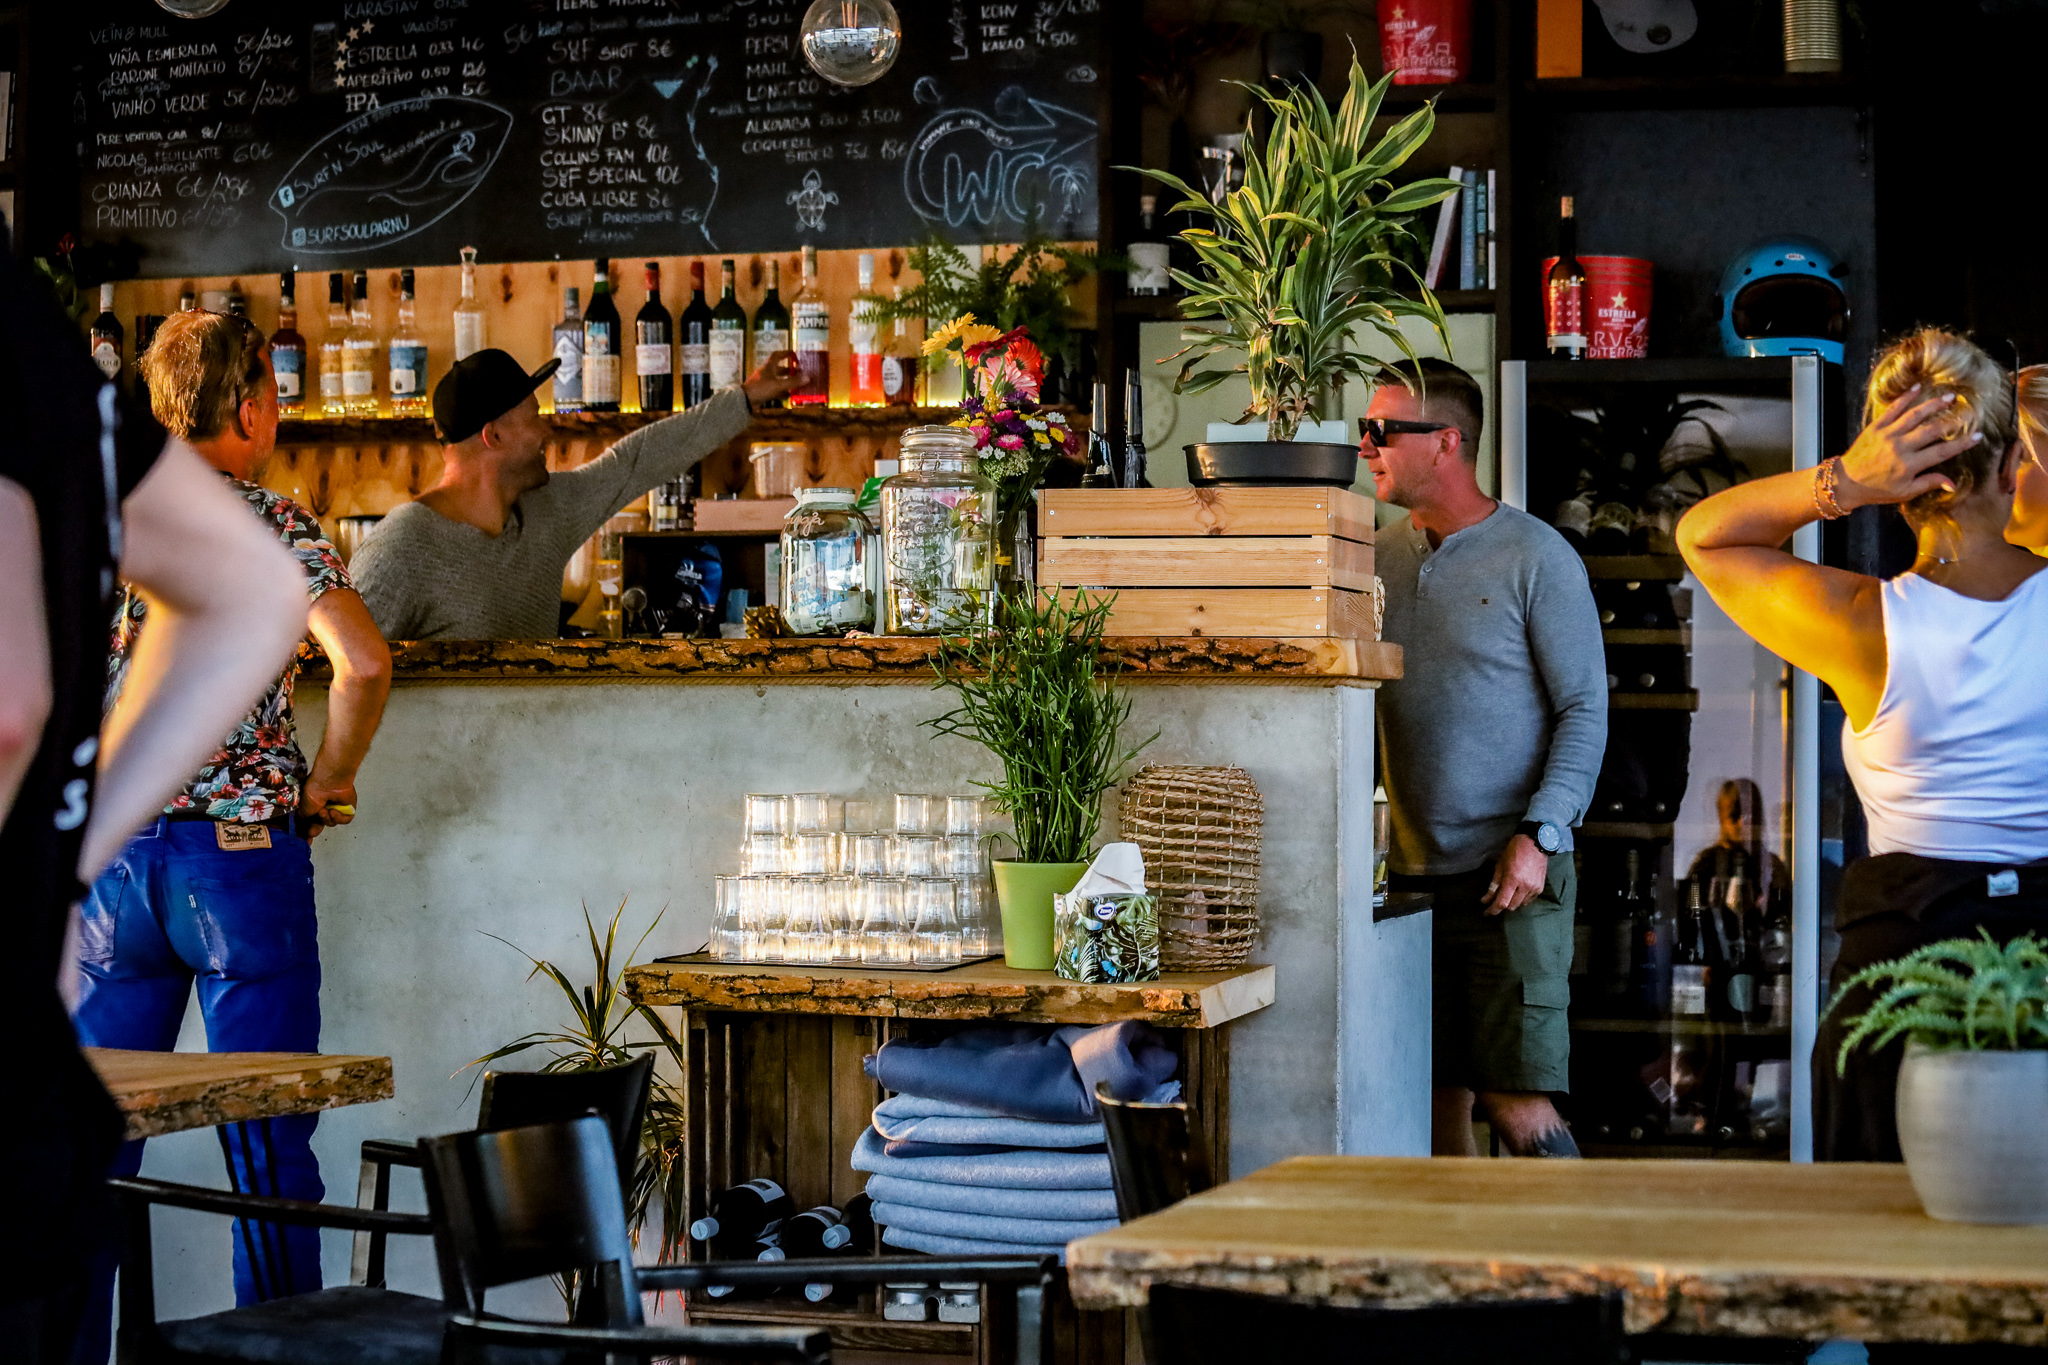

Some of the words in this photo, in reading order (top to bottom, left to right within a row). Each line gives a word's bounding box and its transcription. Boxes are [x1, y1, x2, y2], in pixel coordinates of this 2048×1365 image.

[139, 25, 170, 39] MULL
[979, 24, 1010, 37] TEE
[109, 47, 141, 66] VIÑA
[146, 42, 218, 63] ESMERALDA
[347, 43, 418, 67] ESTRELLA
[598, 42, 639, 61] SHOT
[646, 38, 674, 58] 8€
[110, 67, 160, 87] BARONE
[169, 61, 226, 80] MONTALTO
[346, 66, 414, 88] APERITIVO
[551, 66, 622, 96] BAAR
[112, 99, 156, 119] VINHO
[165, 92, 211, 115] VERDE
[345, 92, 381, 113] IPA
[541, 105, 572, 125] GT
[96, 131, 123, 147] PERE
[543, 123, 604, 148] SKINNY
[97, 152, 147, 170] NICOLAS
[232, 141, 273, 164] 60€
[540, 149, 600, 167] COLLINS
[587, 168, 647, 184] SPECIAL
[91, 181, 163, 203] CRIANZA
[540, 191, 587, 209] CUBA
[592, 190, 638, 208] LIBRE
[96, 202, 177, 229] PRIMITIVO
[1598, 308, 1637, 319] ESTRELLA
